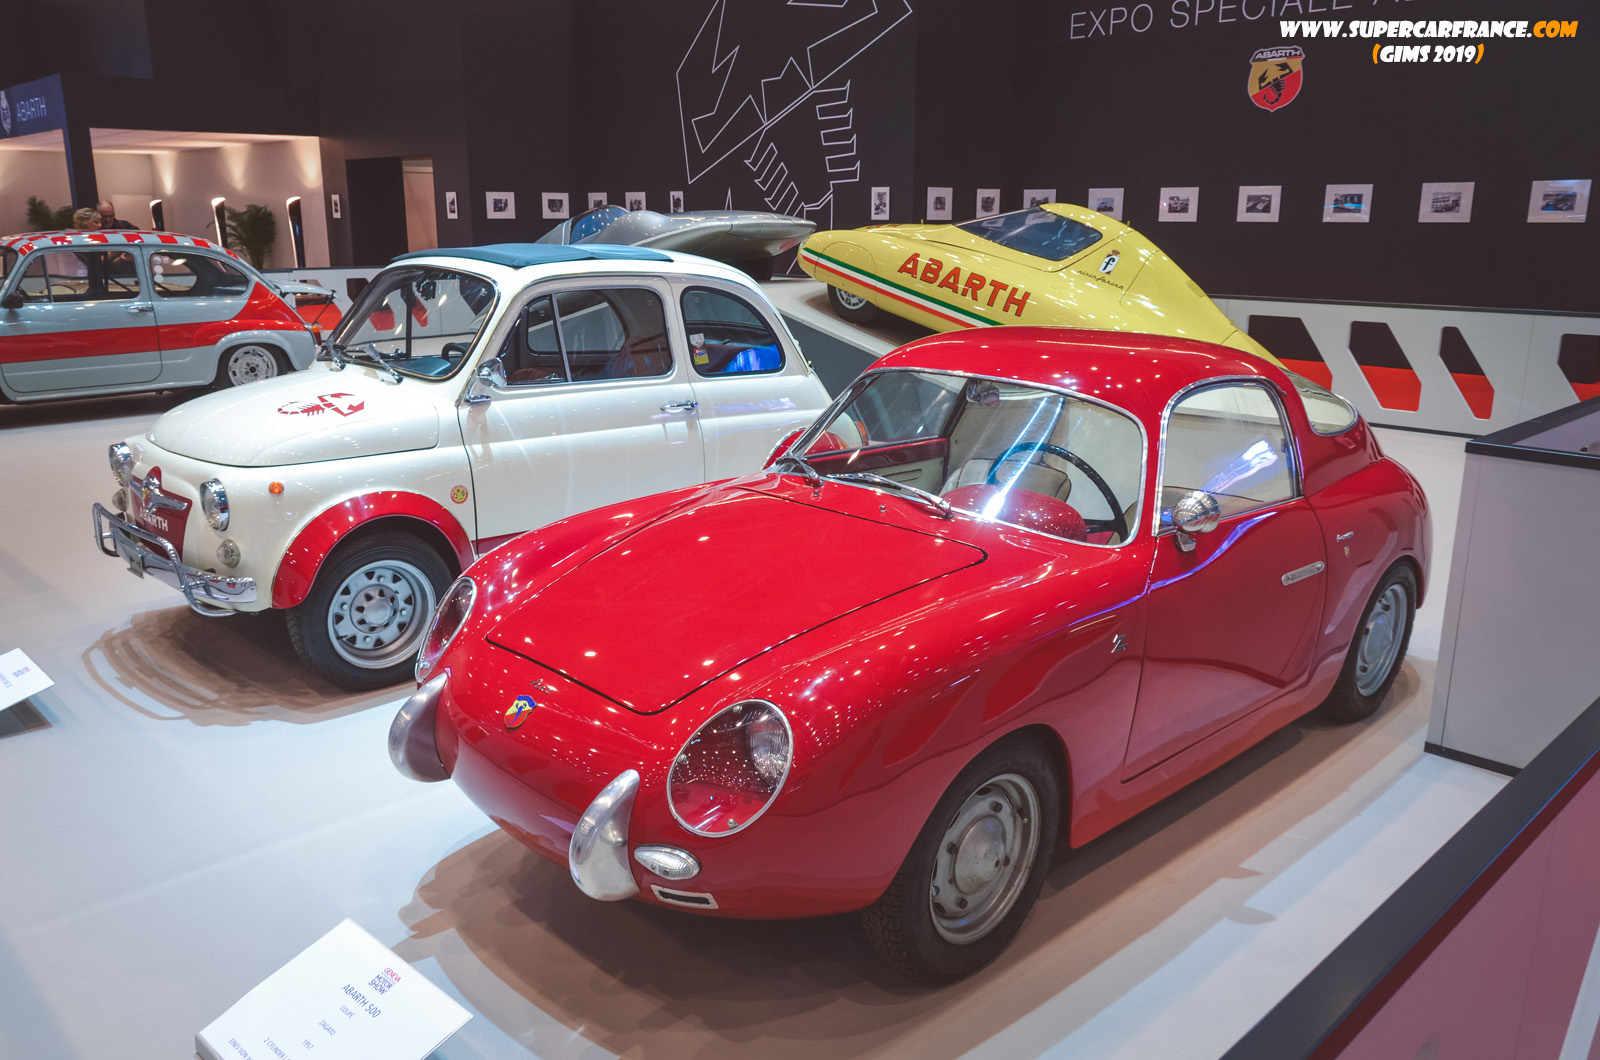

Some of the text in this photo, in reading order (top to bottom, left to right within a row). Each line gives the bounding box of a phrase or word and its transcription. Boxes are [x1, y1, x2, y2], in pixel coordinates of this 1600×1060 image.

[1070, 3, 1153, 39] EXPO
[1254, 49, 1301, 60] ABARTH
[16, 96, 47, 122] ABARTH
[897, 252, 1031, 318] ABARTH
[374, 974, 393, 990] MOTOR
[384, 967, 401, 983] GENEVA
[367, 979, 389, 995] SHOW
[341, 984, 382, 1018] ABARTH 500
[318, 1020, 336, 1036] ZAGATO
[302, 1038, 314, 1050] 1957
